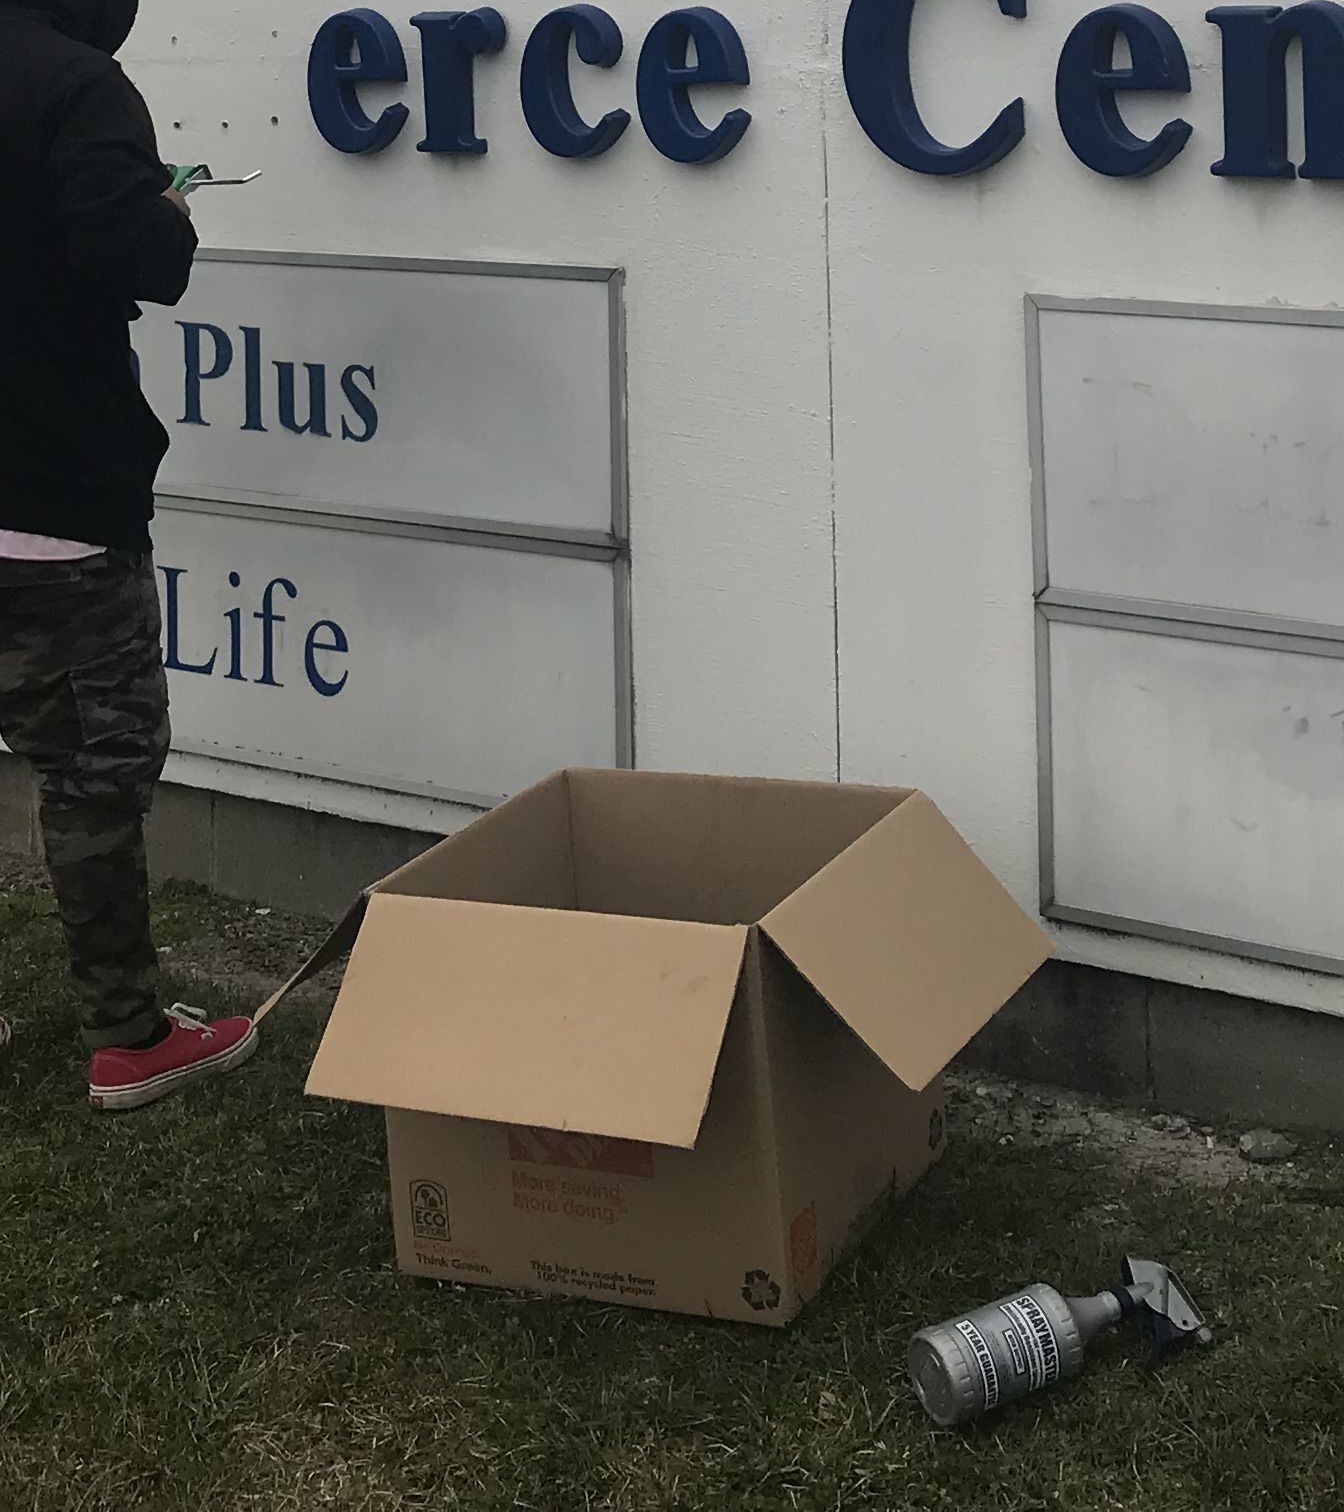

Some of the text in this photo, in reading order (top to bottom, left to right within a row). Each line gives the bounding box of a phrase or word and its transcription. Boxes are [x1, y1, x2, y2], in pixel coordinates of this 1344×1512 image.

[307, 4, 752, 165] erce
[175, 321, 379, 442] Plus
[157, 565, 348, 697] Life
[416, 1210, 446, 1227] ECO
[416, 1253, 448, 1268] Think
[961, 1323, 971, 1331] 5
[966, 1329, 986, 1353] YEAR
[1016, 1296, 1057, 1382] SPRAYMASTE
